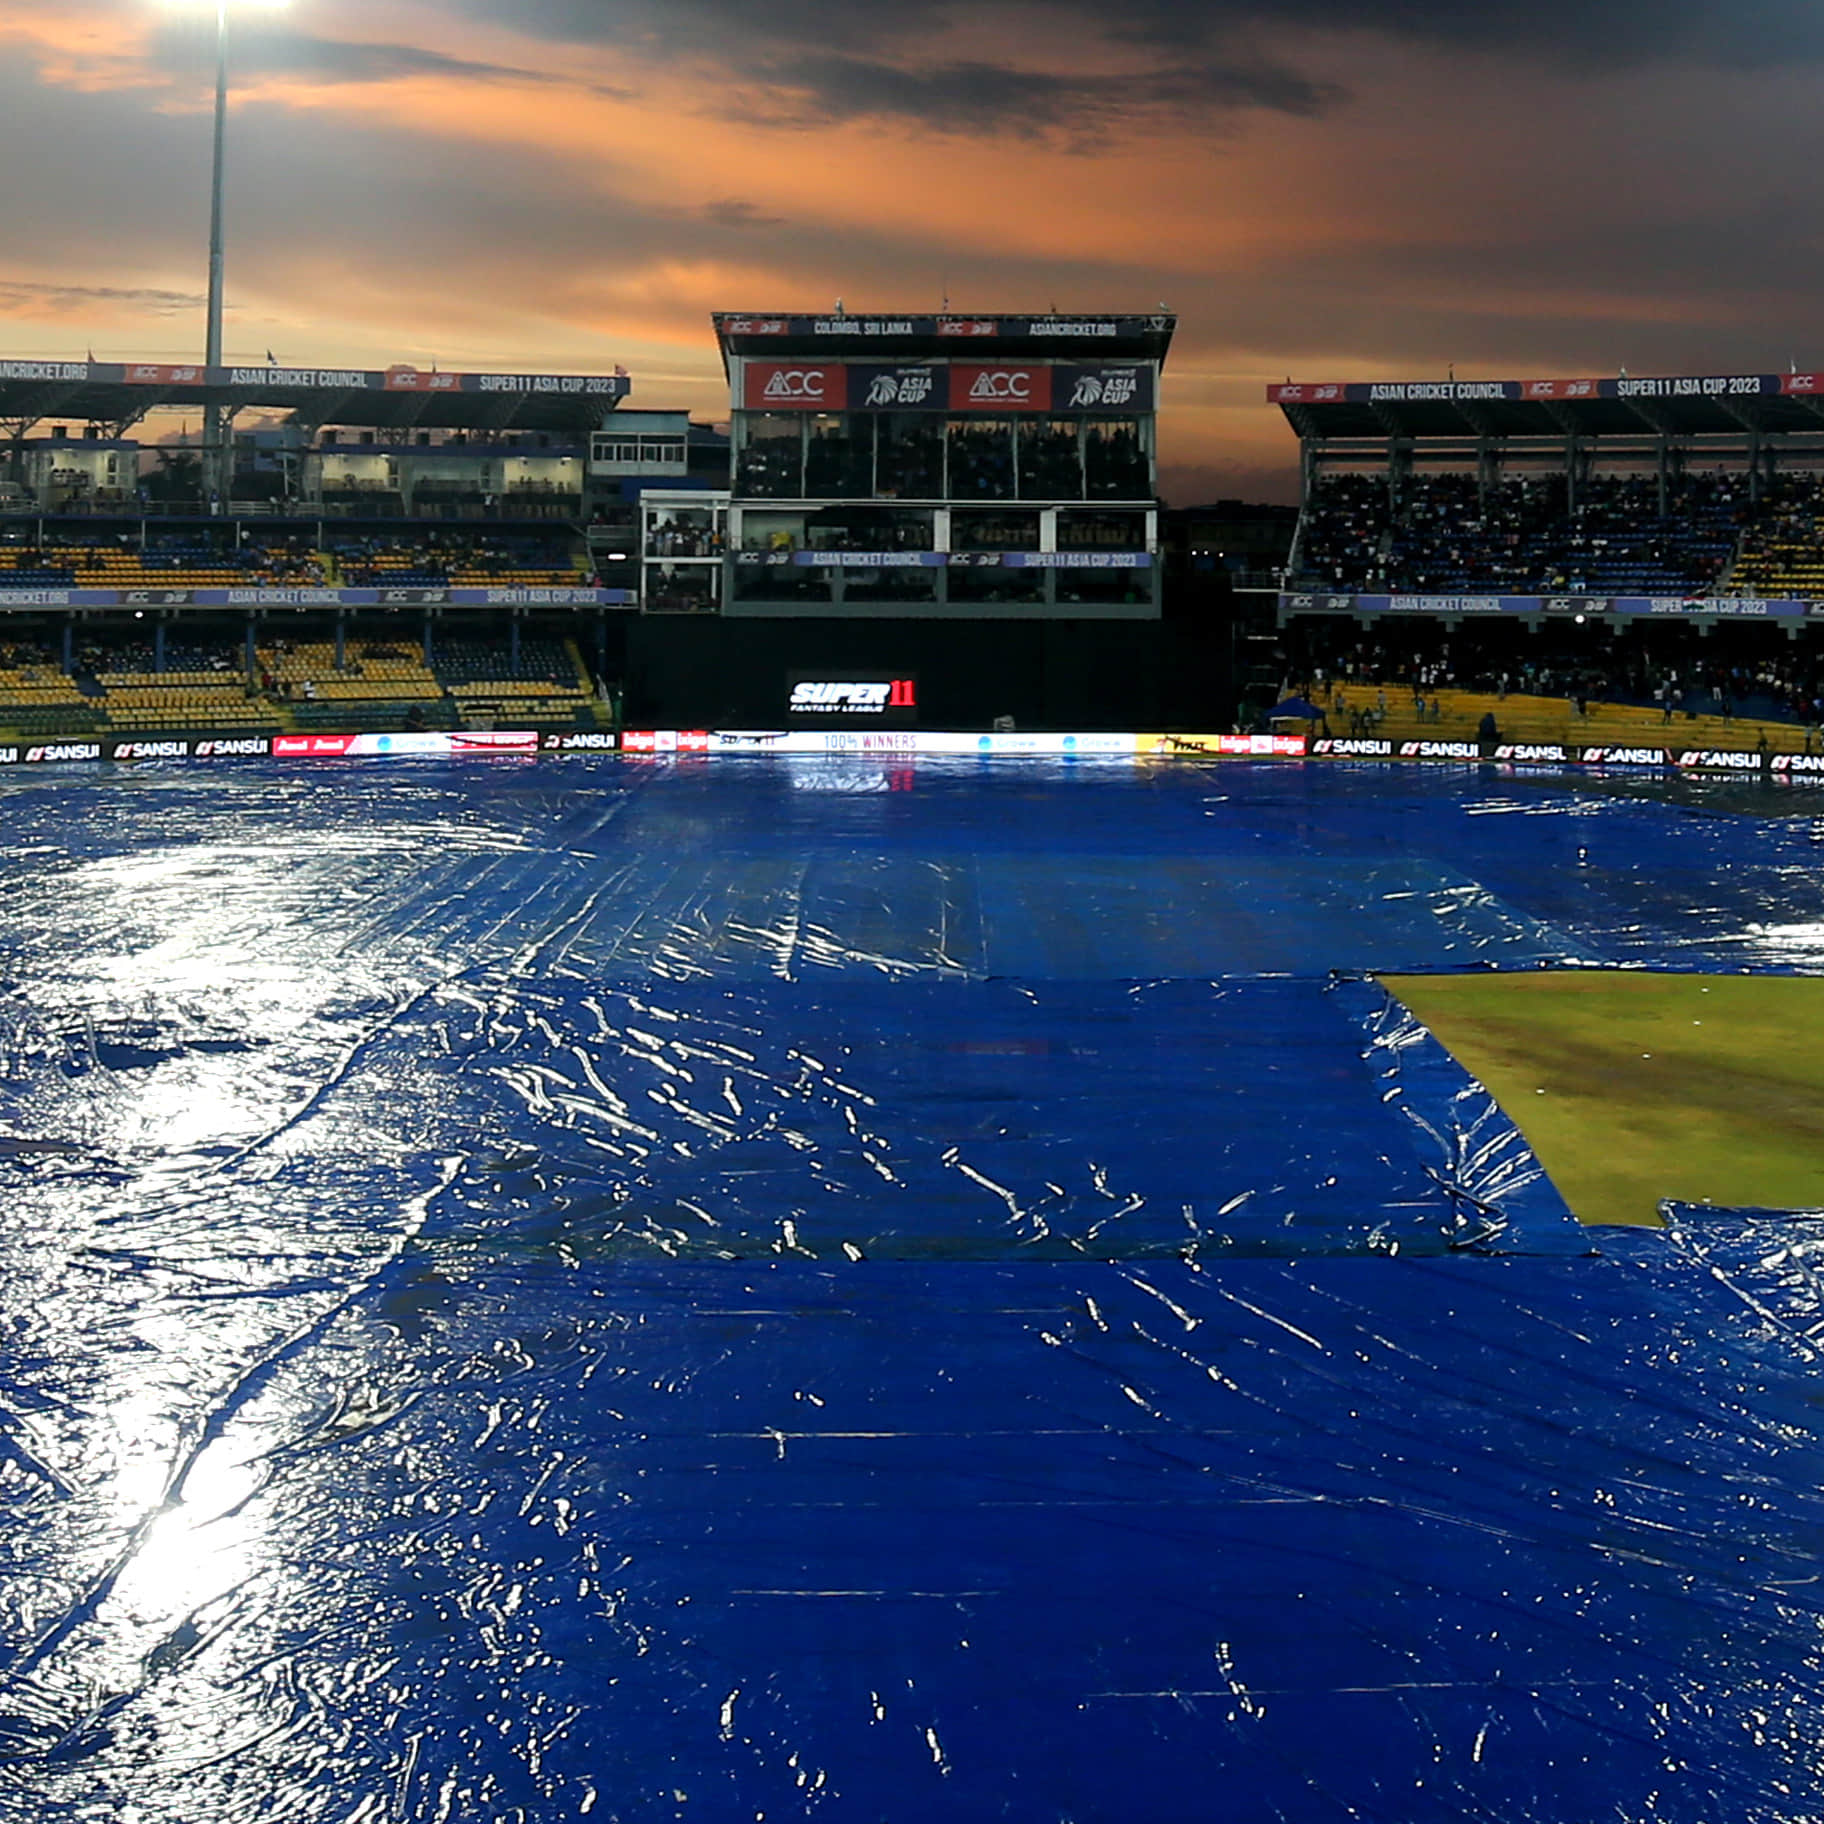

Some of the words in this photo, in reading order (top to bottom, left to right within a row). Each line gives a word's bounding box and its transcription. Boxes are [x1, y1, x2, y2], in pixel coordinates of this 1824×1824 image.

[231, 369, 266, 385] ASIAN
[268, 371, 317, 387] CRICKET
[319, 372, 367, 388] COUNCIL
[479, 377, 531, 391] SUPER11
[533, 378, 559, 392] ASIA
[561, 378, 584, 392] CUP
[586, 379, 615, 393] 2023
[763, 371, 824, 395] ACC
[901, 378, 932, 390] ASIA
[969, 373, 1029, 396] ACC
[1105, 379, 1137, 391] ASIA
[1371, 385, 1405, 400] ASIAN
[1407, 385, 1454, 400] CRICKET
[1457, 383, 1505, 399] COUNCIL
[1618, 380, 1672, 397] SUPER11
[1674, 380, 1700, 396] ASIA
[1702, 379, 1727, 394] CUP
[1729, 378, 1760, 393] 2023
[898, 390, 925, 403] CUP
[1102, 392, 1130, 404] CUP
[1390, 597, 1418, 611] ASIAN
[1420, 597, 1454, 611] CRICKET
[1457, 597, 1501, 611] COUNCIL
[1719, 601, 1738, 614] CUP
[1740, 601, 1766, 615] 2023
[790, 682, 890, 704] SUPER
[889, 680, 915, 706] 11
[133, 742, 187, 757] SANSUI
[214, 740, 267, 755] SANSUI
[863, 735, 916, 749] WINNERS
[1333, 741, 1391, 754] SANSUI
[44, 745, 99, 760] SANSUI
[1419, 742, 1479, 758] SANSUI
